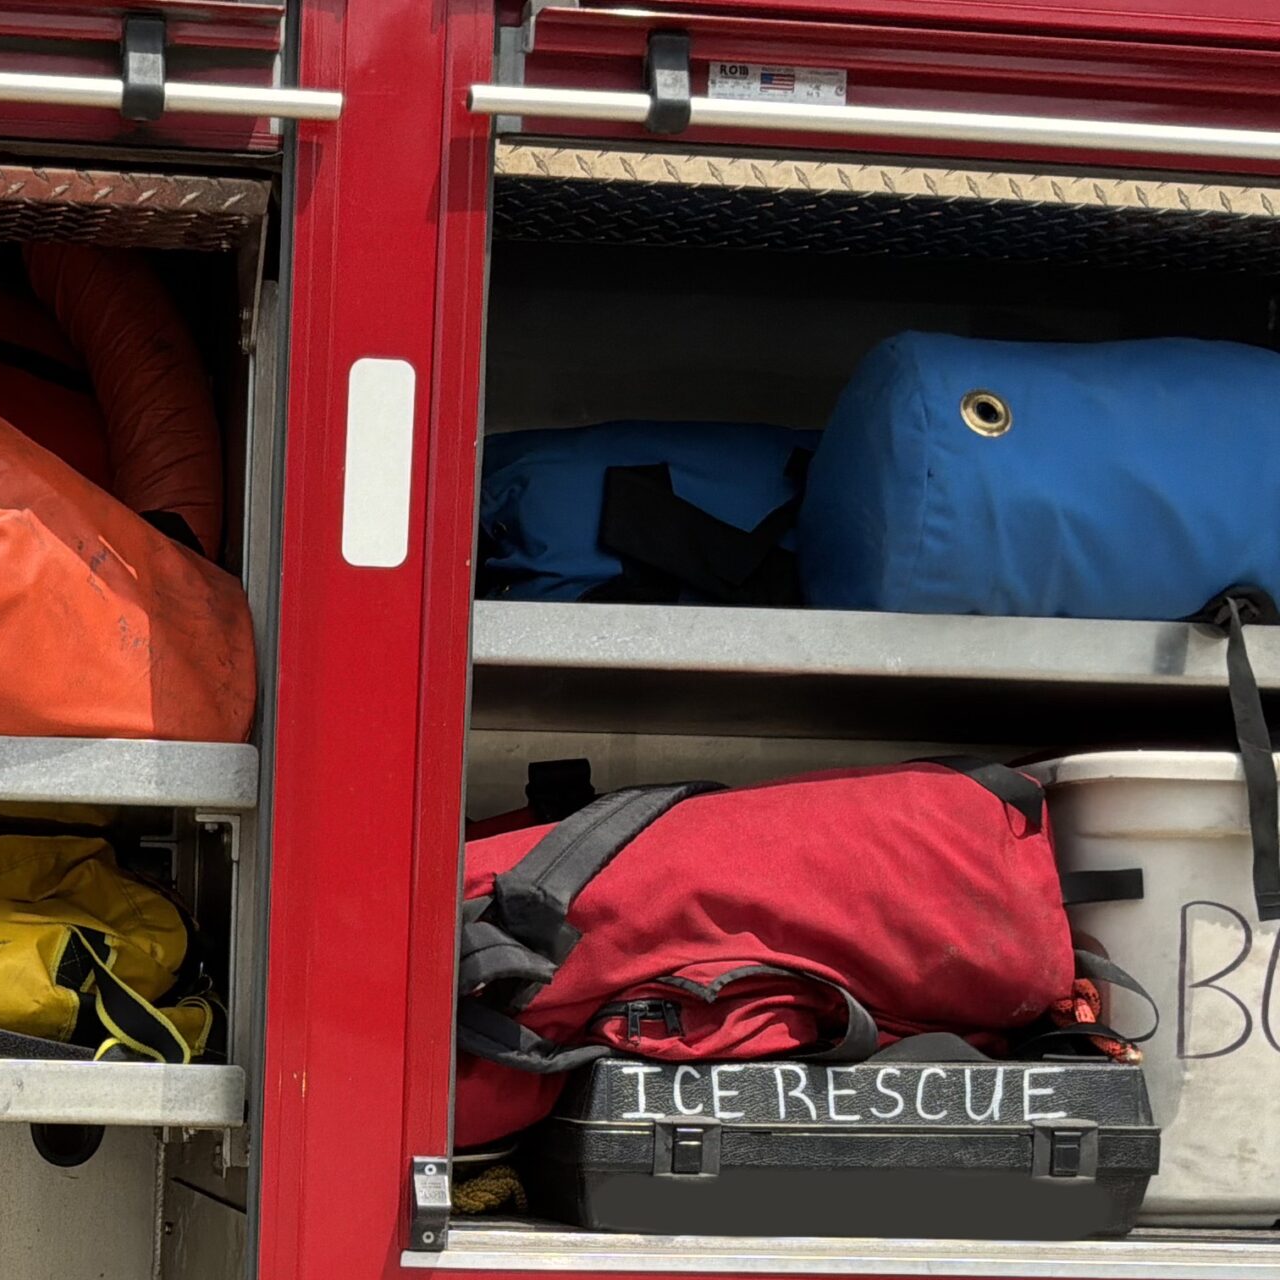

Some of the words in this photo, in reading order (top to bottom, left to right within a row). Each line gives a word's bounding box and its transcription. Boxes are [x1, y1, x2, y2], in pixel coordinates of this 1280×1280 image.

[1176, 900, 1280, 1060] B
[622, 1065, 745, 1119] ICE
[774, 1064, 1068, 1121] RESCUE
